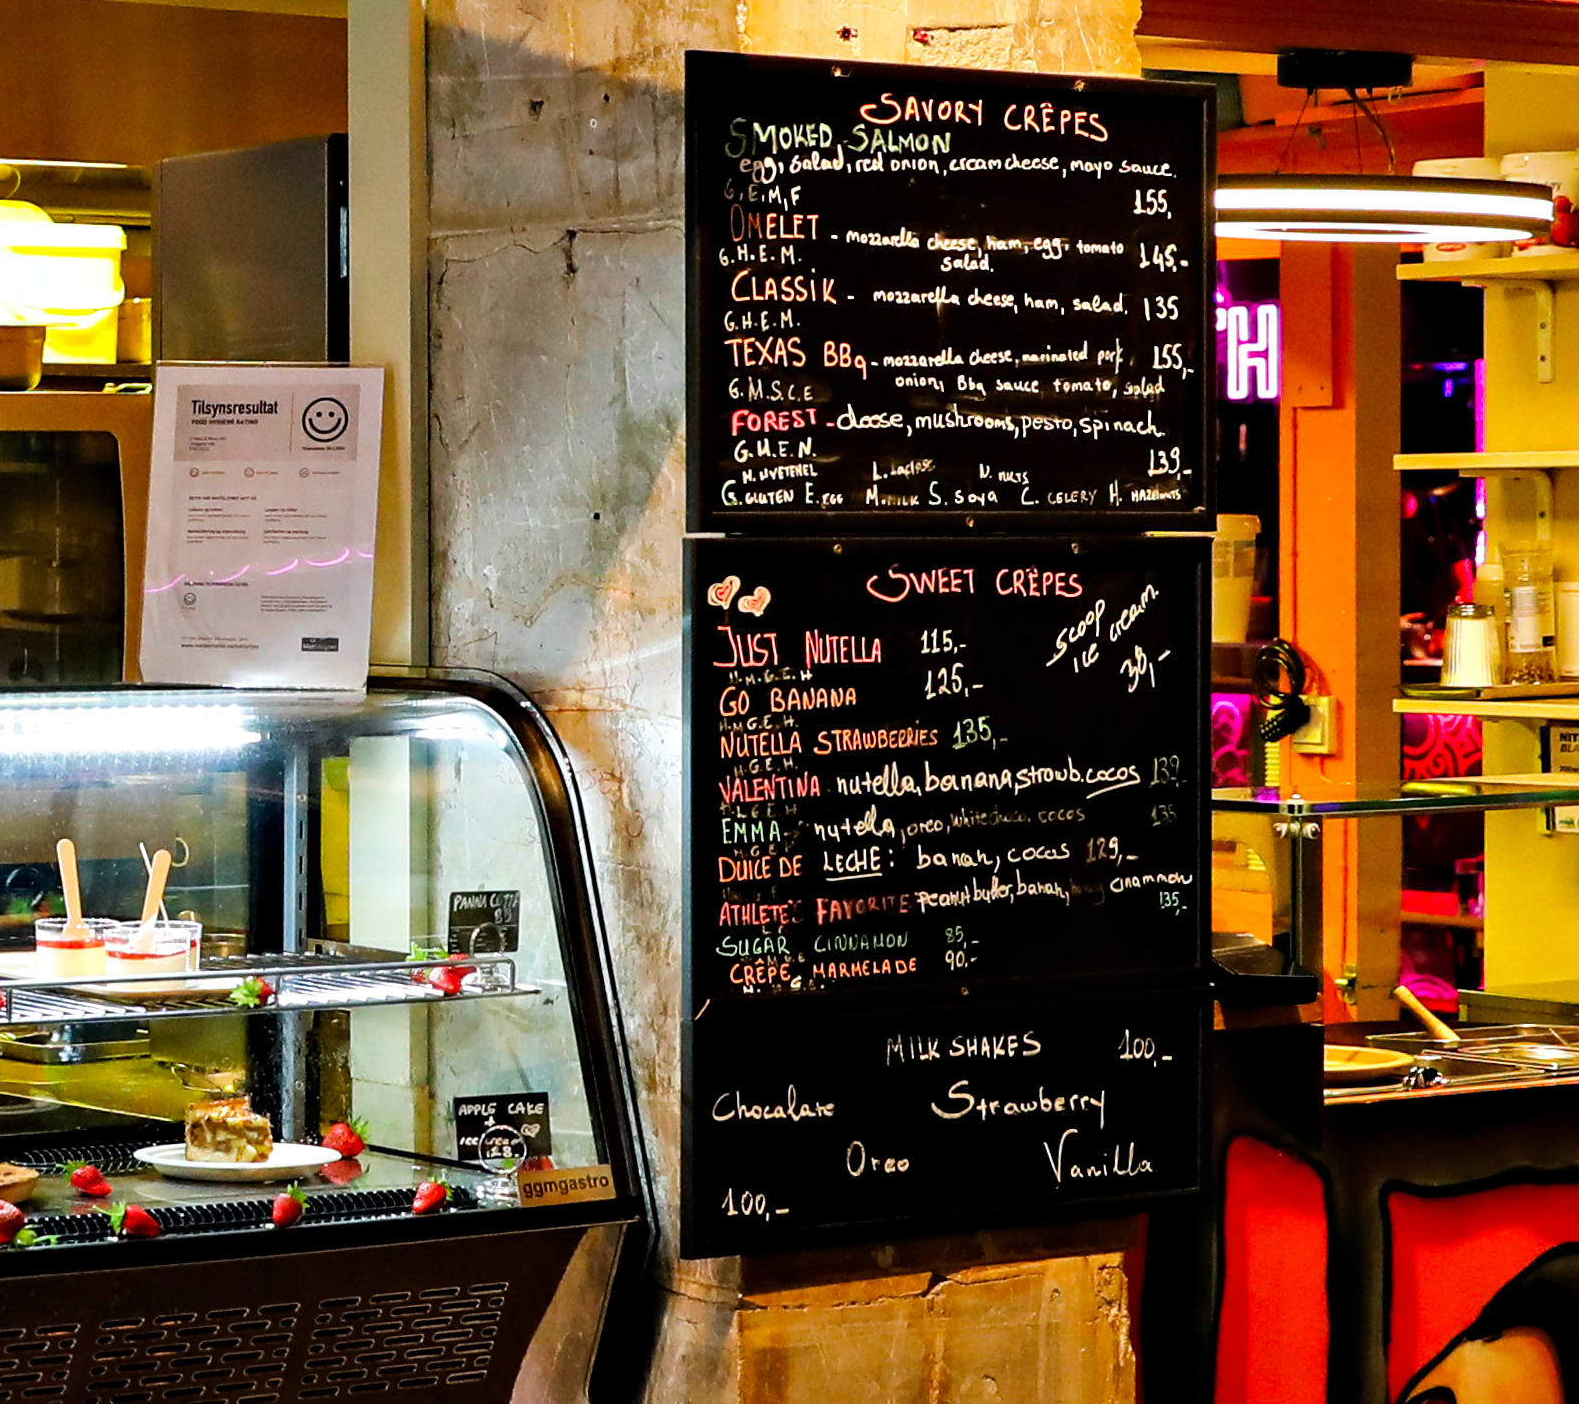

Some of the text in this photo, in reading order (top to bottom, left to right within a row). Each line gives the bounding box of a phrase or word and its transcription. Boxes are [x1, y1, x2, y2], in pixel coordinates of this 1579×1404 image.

[859, 93, 1109, 142] SAVORY CRÊPES
[847, 123, 952, 155] SALMON
[1070, 160, 1114, 180] mayo
[730, 203, 819, 243] OMELET
[846, 226, 920, 249] mozzarella
[1076, 239, 1125, 255] tomato
[940, 252, 995, 273] salad.
[873, 285, 961, 306] mozzarella
[1143, 295, 1179, 321] 135
[724, 336, 807, 368] TEXAS
[883, 346, 964, 367] mozzarella
[995, 378, 1040, 393] sauce
[1122, 374, 1166, 398] salad
[191, 399, 279, 419] Tilsynsresultat
[731, 407, 817, 437] FOREST
[1047, 489, 1098, 506] CELERY
[867, 564, 975, 602] SWEET
[712, 625, 779, 667] JUST
[805, 628, 882, 670] NUTELLA
[1045, 598, 1106, 667] scoop
[719, 685, 750, 717] GO
[770, 686, 857, 713] BANANA
[720, 730, 802, 759] NUTELLA
[718, 770, 821, 804] VALENTINA
[1085, 764, 1141, 793] cocos
[721, 817, 781, 844] EMMA
[1037, 806, 1086, 824] cocos
[779, 854, 803, 878] DE
[1007, 842, 1071, 863] cocos
[453, 894, 488, 912] PANNA
[815, 893, 911, 926] FAVORITE
[715, 934, 791, 957] SUGAR
[813, 930, 909, 953] CINNAMON
[729, 957, 792, 986] CRÊPE
[812, 956, 917, 980] MARMELADE
[886, 1033, 941, 1066] MILK
[949, 1030, 1041, 1059] SHAKES
[458, 1101, 545, 1117] APPLE CAKE
[931, 1080, 1105, 1129] Strawberry
[846, 1128, 1154, 1183] Oreo Vanilla
[523, 1174, 610, 1198] ggmgastro
